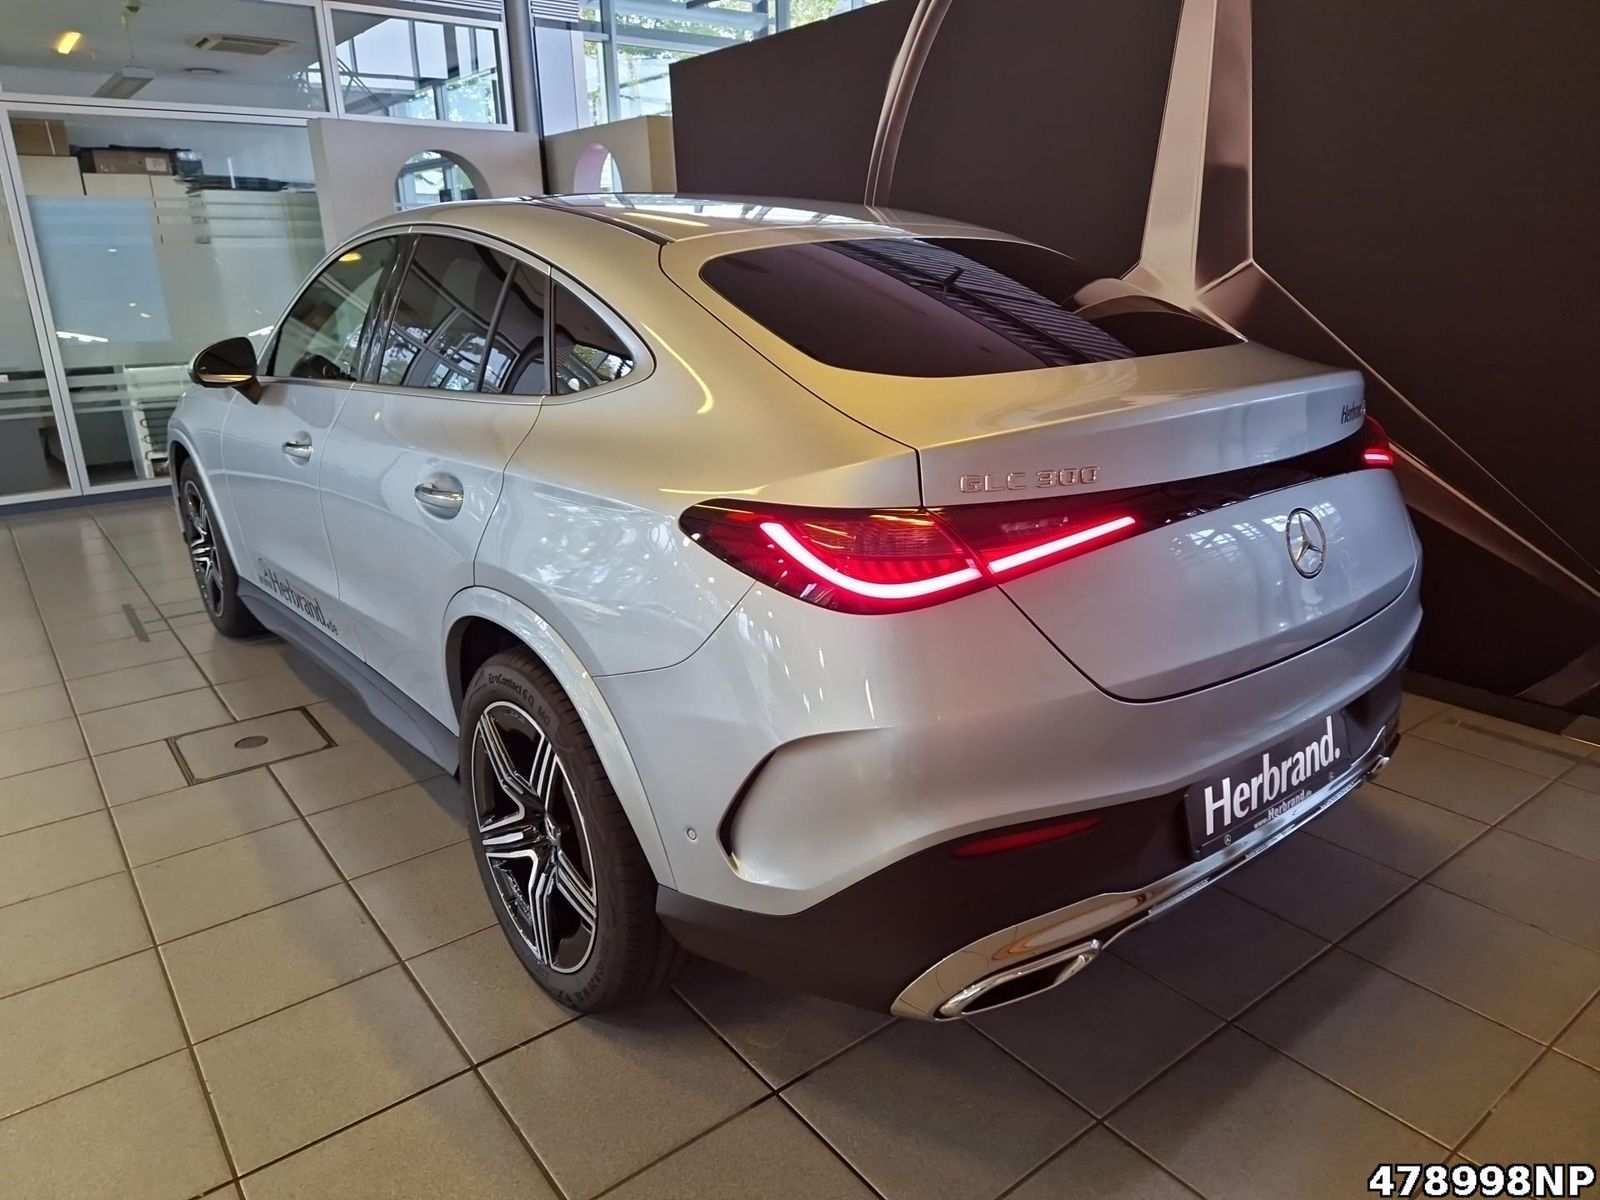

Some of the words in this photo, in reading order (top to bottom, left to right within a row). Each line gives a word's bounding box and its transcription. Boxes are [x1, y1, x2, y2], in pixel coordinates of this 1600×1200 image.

[959, 472, 1027, 493] GLC
[1036, 466, 1100, 488] 300
[1204, 715, 1341, 836] Herbrand.
